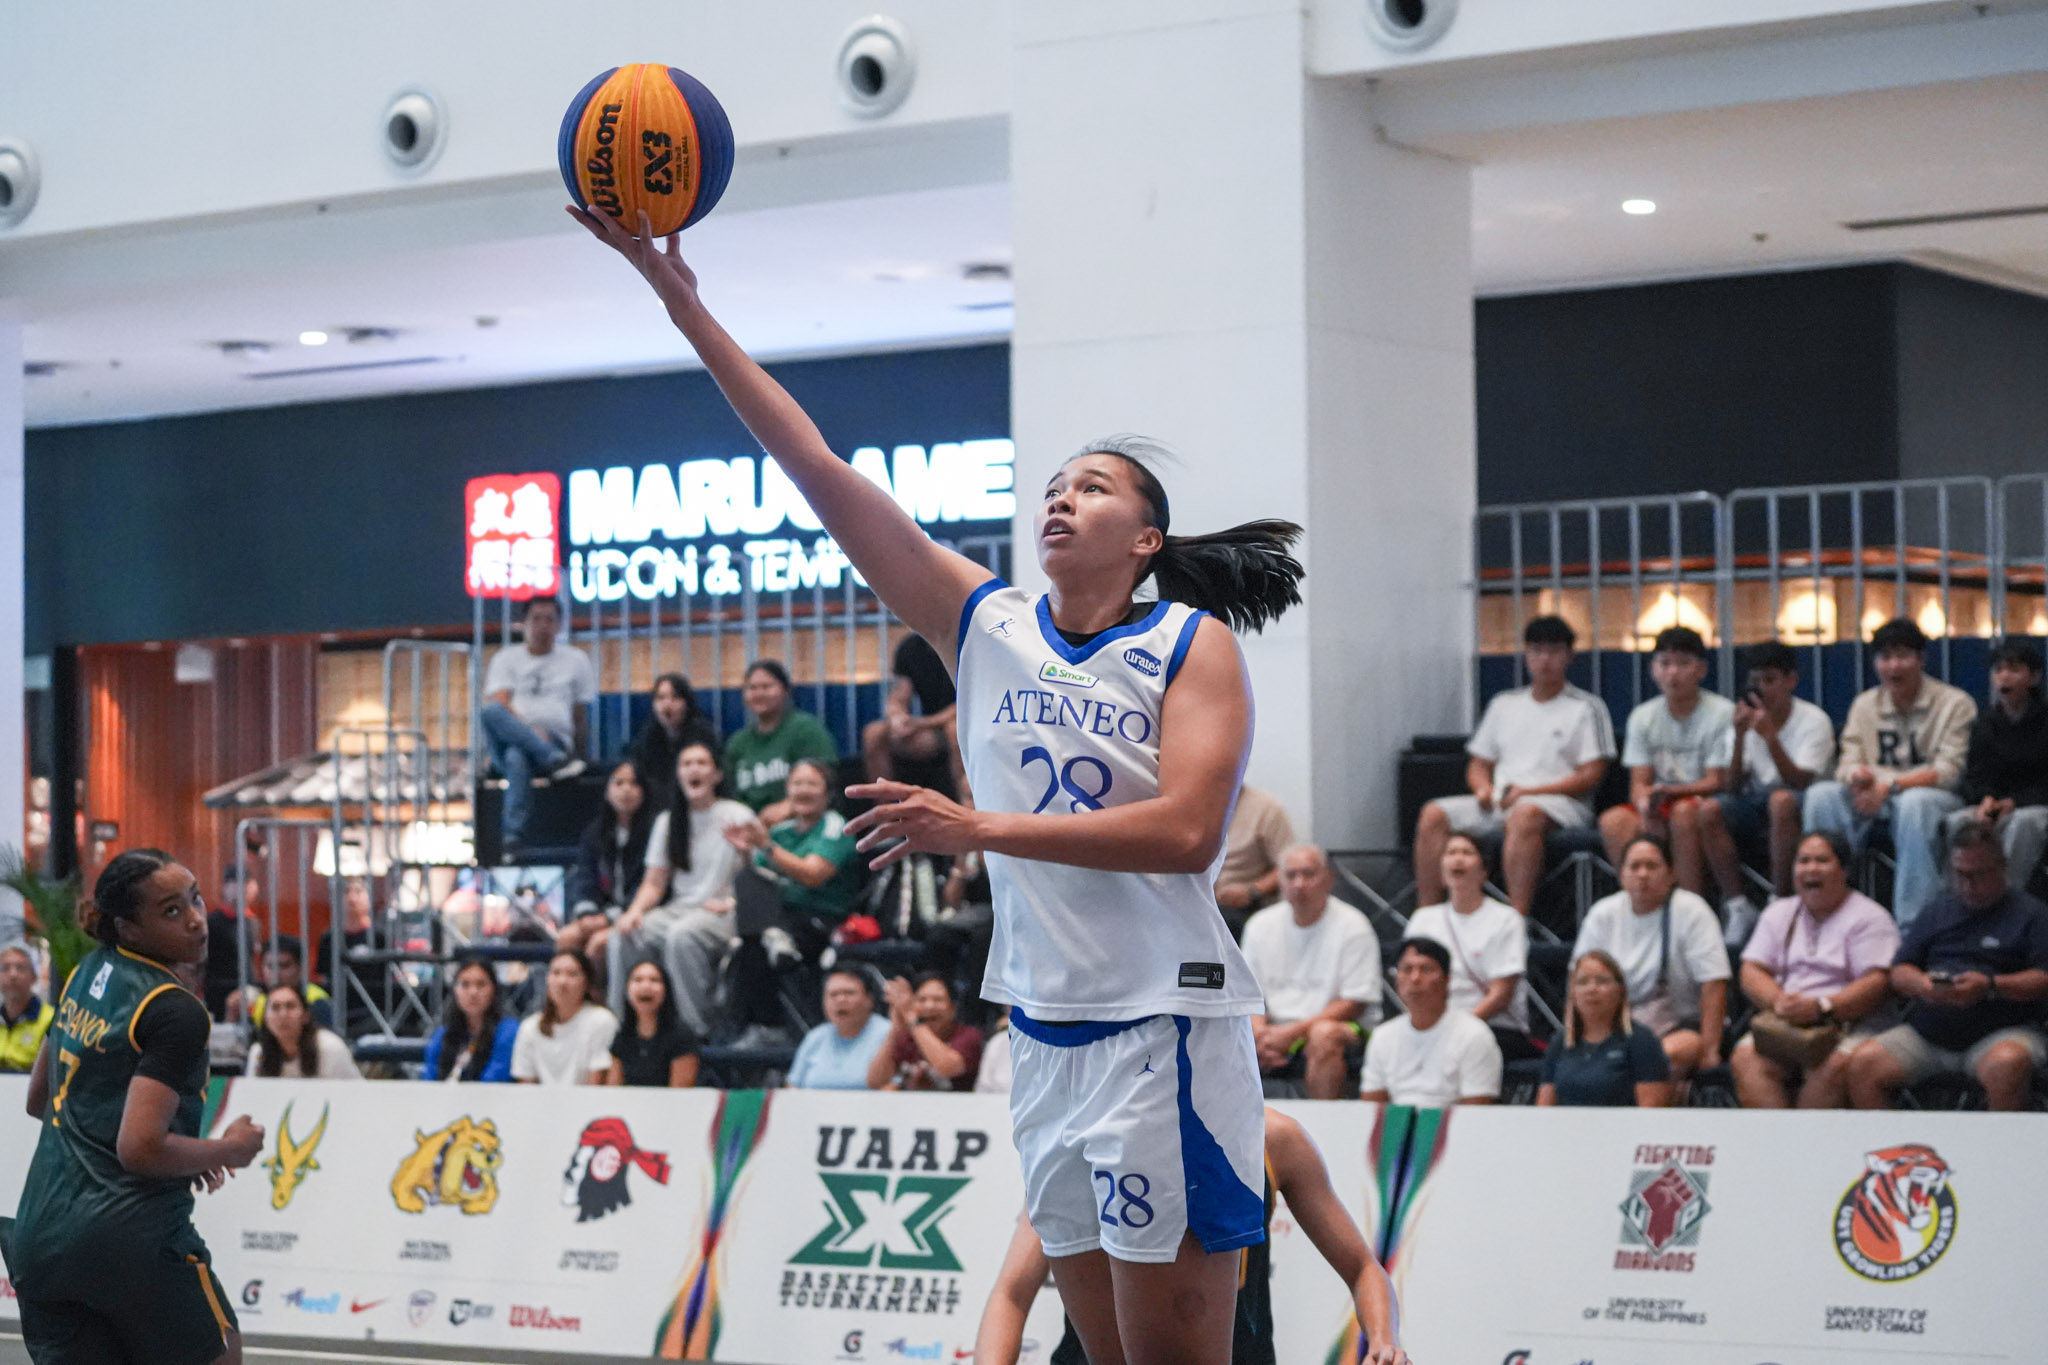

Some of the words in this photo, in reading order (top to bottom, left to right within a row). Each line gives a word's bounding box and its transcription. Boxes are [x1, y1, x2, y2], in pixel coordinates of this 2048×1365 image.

[587, 103, 623, 218] Wilson
[569, 438, 1016, 545] MARUAME
[569, 544, 698, 602] UDON
[703, 543, 741, 595] &
[1059, 669, 1092, 683] Smart
[992, 689, 1151, 743] ATENEO
[1021, 746, 1113, 814] 28
[1212, 971, 1223, 982] XL
[816, 1126, 990, 1171] UAAP
[1633, 1145, 1716, 1165] FIGHTING
[1094, 1170, 1154, 1228] 28
[1837, 1205, 1854, 1238] UST
[1920, 1205, 1954, 1264] TIGERS
[1841, 1241, 1919, 1279] GROWLING
[781, 1270, 959, 1296] BASKETBALL
[780, 1289, 961, 1315] TOURNAMENT
[1582, 1307, 1600, 1320] OF
[1604, 1307, 1626, 1321] THE
[1630, 1309, 1708, 1326] PHILIPPINES
[1608, 1296, 1686, 1310] UNIVERSITY
[1826, 1305, 1905, 1321] UNIVERSITY
[1910, 1308, 1928, 1321] OF
[509, 1304, 581, 1332] Wilson
[1825, 1319, 1873, 1332] SANTO
[1877, 1320, 1925, 1334] TOMAS
